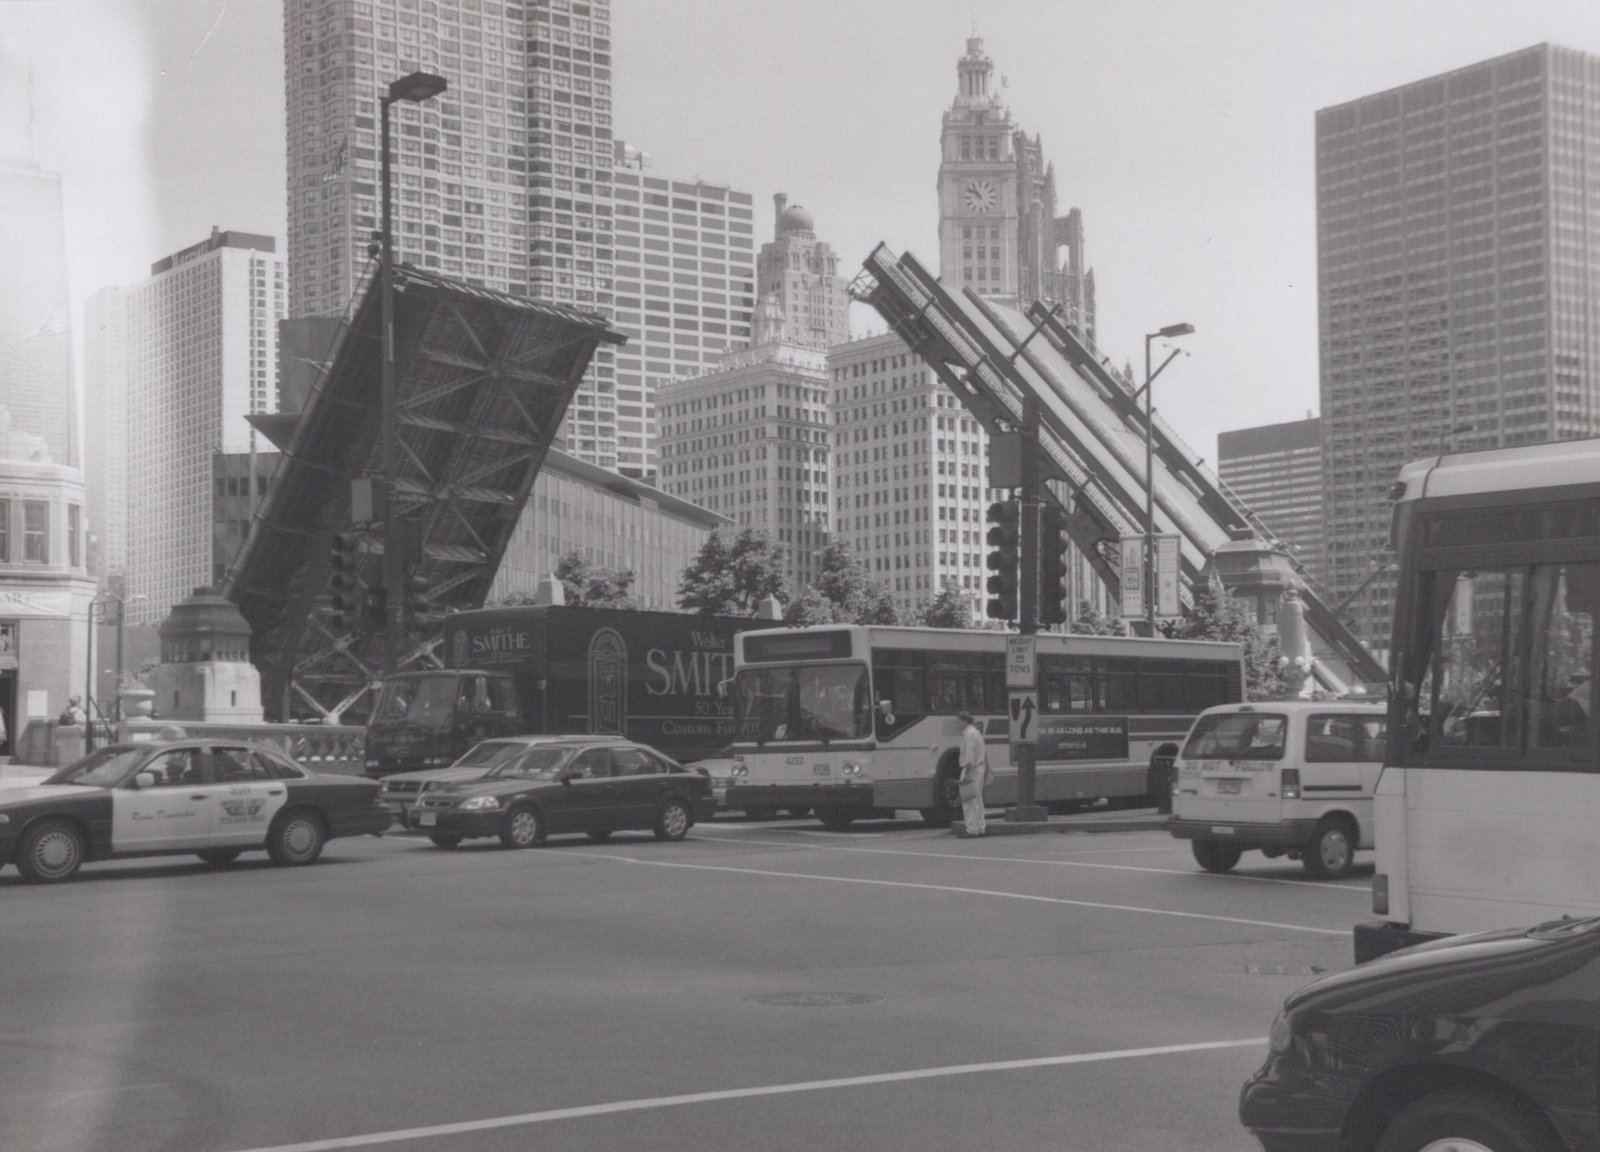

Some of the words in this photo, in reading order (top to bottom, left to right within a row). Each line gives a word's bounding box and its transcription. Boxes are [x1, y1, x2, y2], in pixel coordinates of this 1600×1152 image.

[472, 632, 530, 653] SMITHE
[690, 631, 727, 649] Walter
[1009, 638, 1033, 646] WEIGHT
[1012, 646, 1029, 654] LIMIT
[1015, 654, 1025, 664] 15
[1009, 665, 1031, 673] TONS
[695, 701, 711, 716] 50
[662, 720, 711, 735] Custom
[1186, 761, 1199, 771] DO
[1202, 761, 1220, 772] NOT
[1234, 761, 1275, 773] FOLLOW
